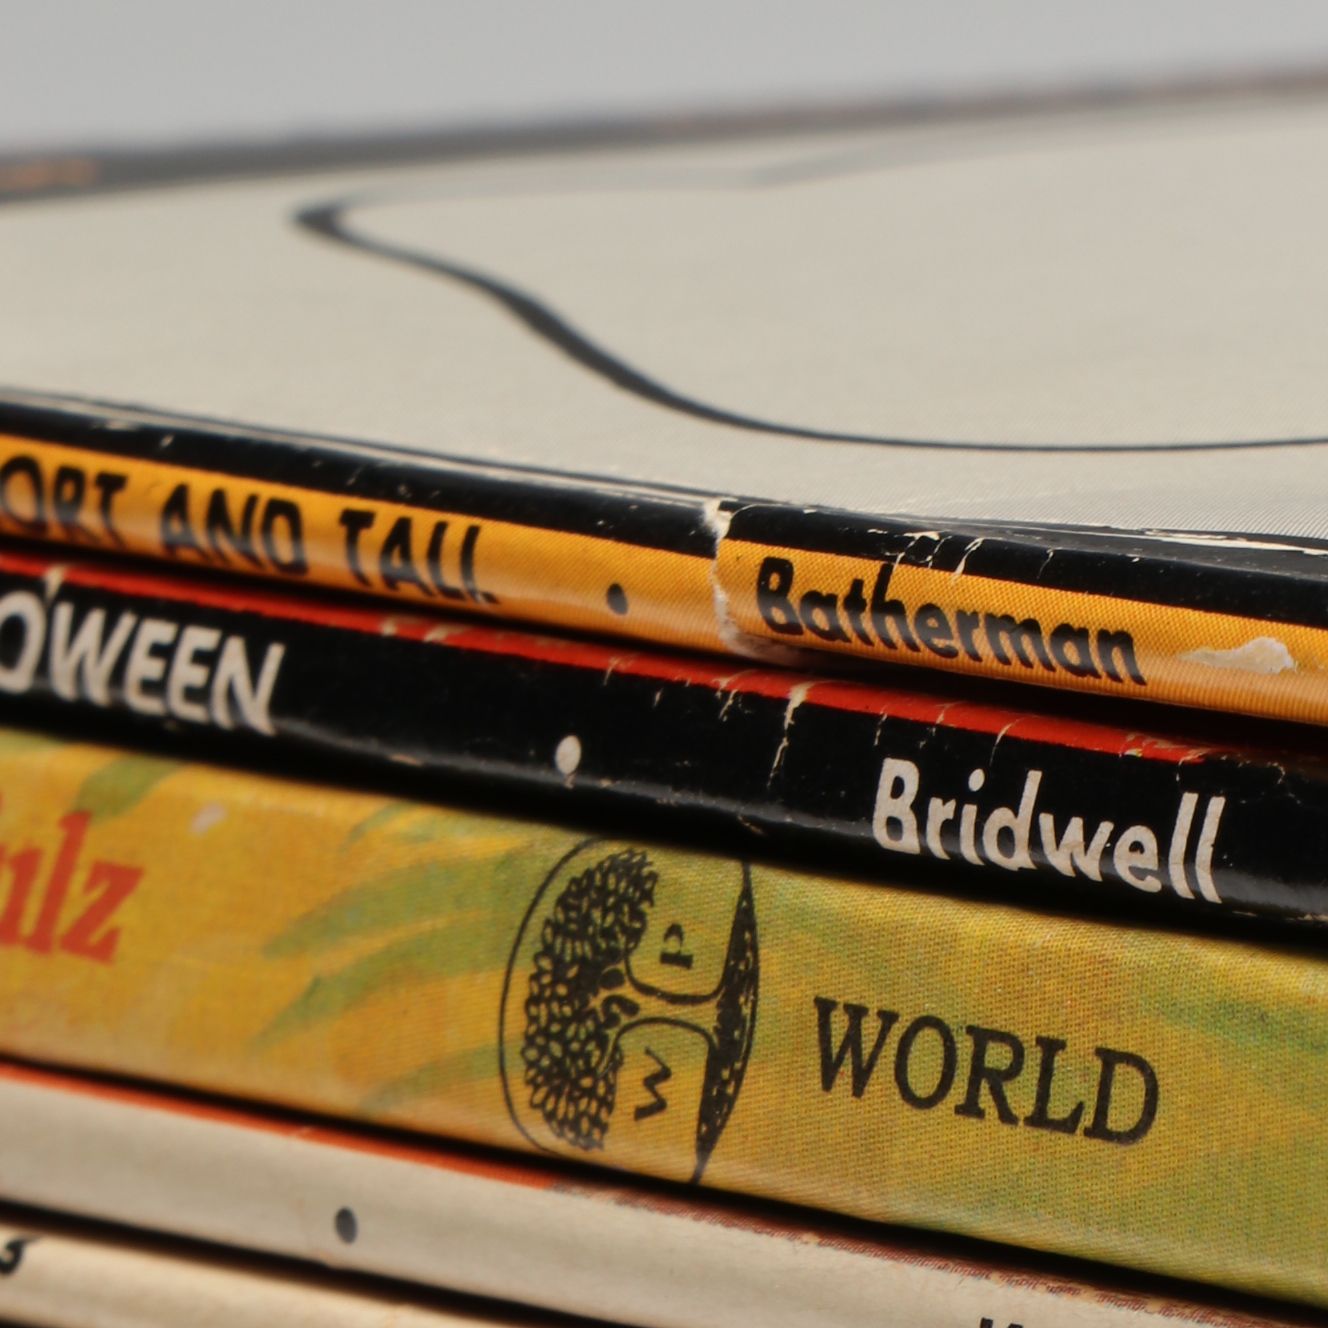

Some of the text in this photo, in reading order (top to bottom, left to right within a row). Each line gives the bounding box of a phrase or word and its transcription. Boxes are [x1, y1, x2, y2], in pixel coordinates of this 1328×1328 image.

[160, 483, 309, 575] AND
[339, 508, 501, 606] TALL
[756, 557, 1147, 686] Batherman
[872, 758, 1226, 904] Bridwell
[814, 996, 1158, 1145] WORLD
